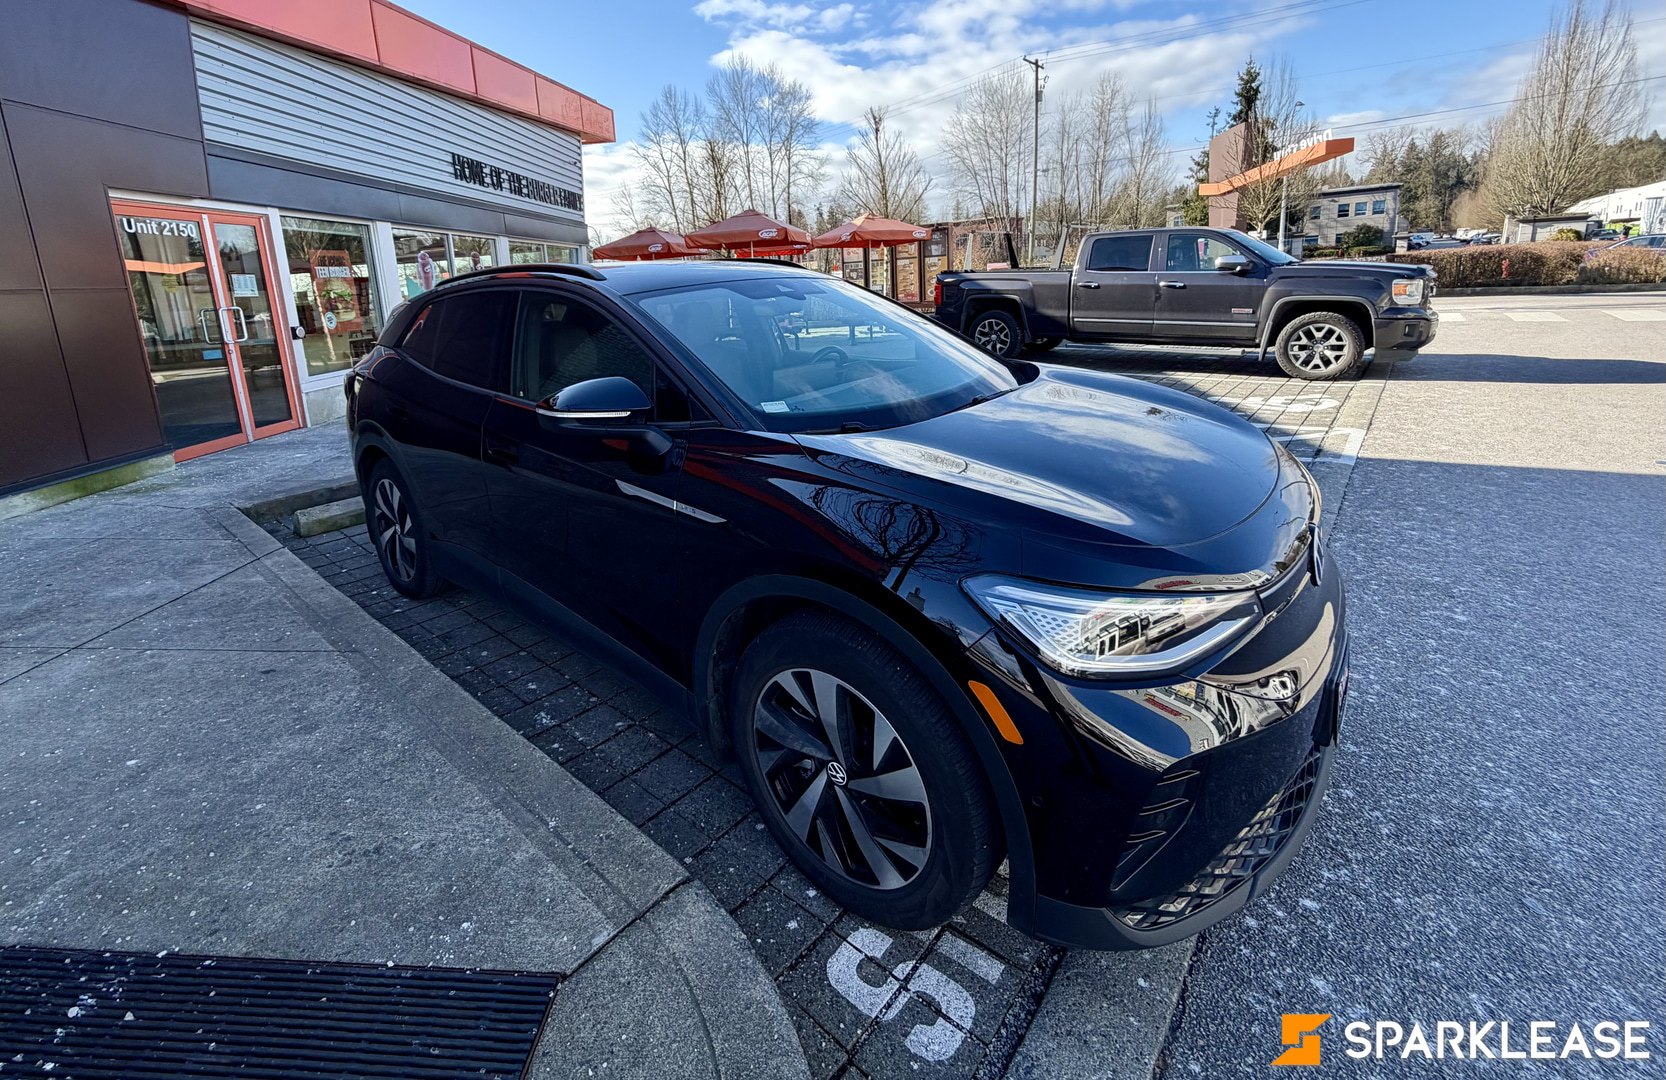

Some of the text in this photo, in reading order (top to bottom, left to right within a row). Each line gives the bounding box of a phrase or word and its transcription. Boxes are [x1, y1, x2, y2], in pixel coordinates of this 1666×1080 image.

[452, 152, 489, 188] HOME
[490, 164, 504, 191] OF
[505, 170, 528, 198] THE
[527, 177, 561, 207] BURGER
[122, 217, 196, 237] Unit 2150
